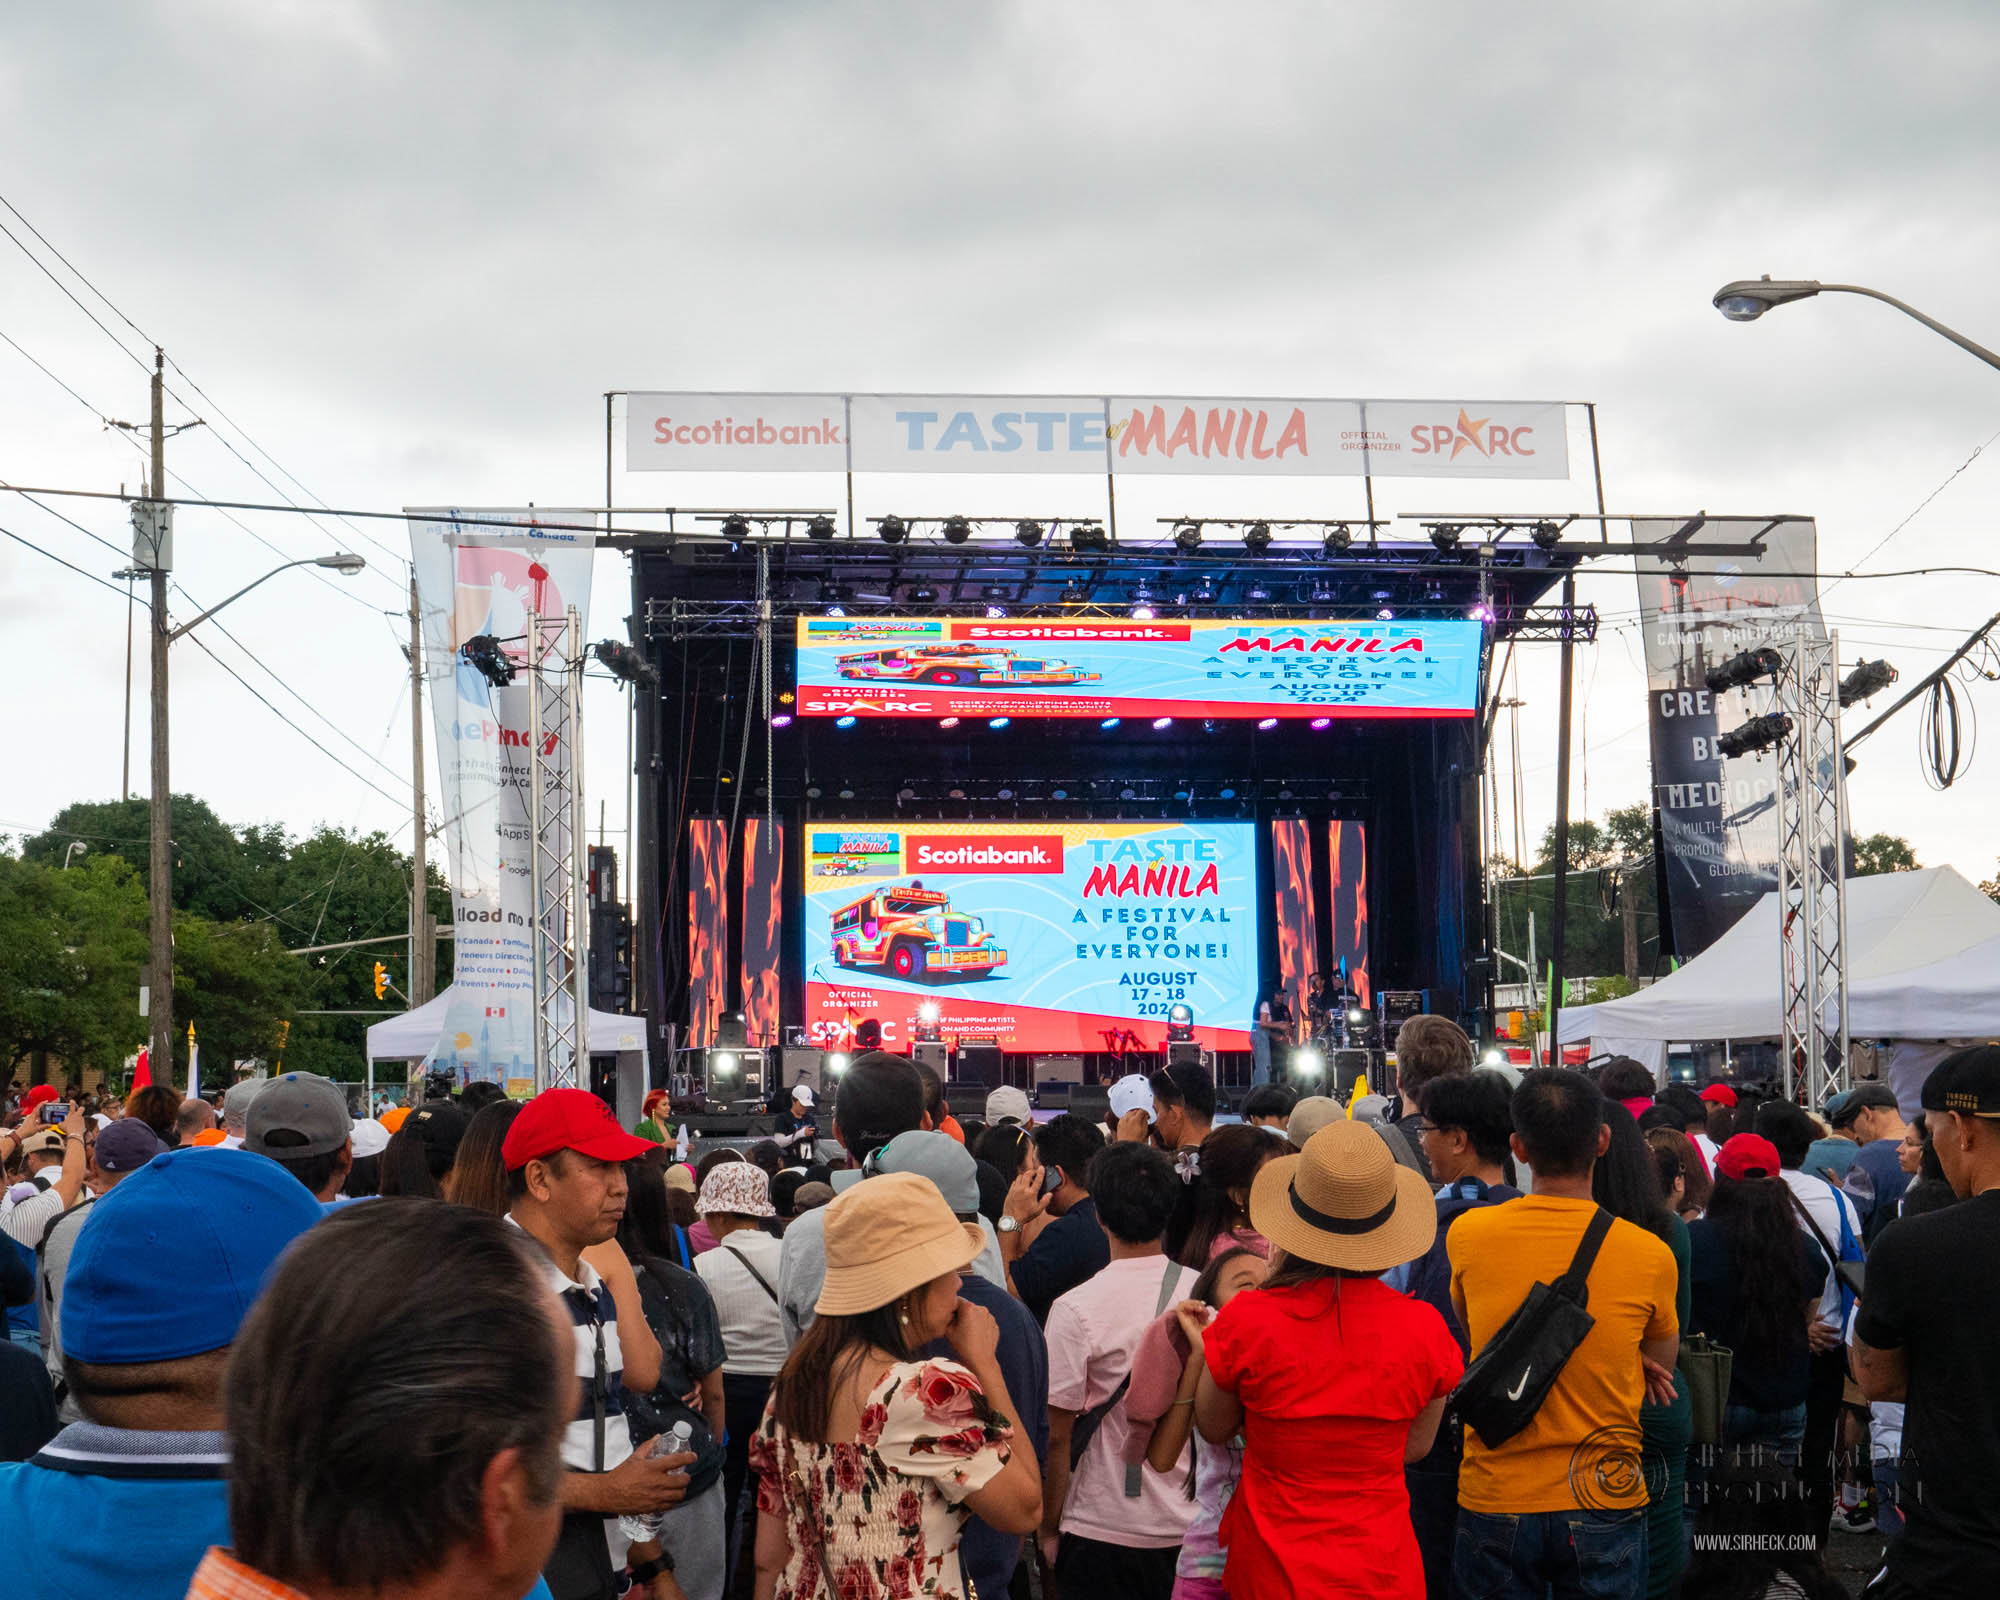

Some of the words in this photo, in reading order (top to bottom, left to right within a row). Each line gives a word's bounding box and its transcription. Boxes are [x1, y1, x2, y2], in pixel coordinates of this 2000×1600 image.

[895, 411, 1107, 452] TASTE
[1118, 404, 1309, 460] MANILA
[1340, 431, 1389, 441] OFFICIAL
[1341, 441, 1402, 452] ORGANIZER
[1225, 627, 1424, 638] TASTE
[1656, 630, 1713, 646] CANADA
[1217, 637, 1424, 653] MANILA
[1202, 656, 1225, 664] A
[1247, 656, 1440, 664] FESTIVAL
[1206, 671, 1434, 679] EVERYONE!
[839, 842, 889, 853] MANILA
[1086, 839, 1217, 862] TASTE
[1082, 863, 1219, 898] MANILA
[1072, 908, 1088, 923] A
[1102, 908, 1231, 923] FESTIVAL
[1126, 926, 1178, 941] FOR
[460, 952, 493, 961] reneurs
[1076, 943, 1228, 959] EVERYONE!
[1119, 972, 1198, 986] AUGUST
[1131, 988, 1149, 1000] 17
[1167, 988, 1185, 1000] 18
[1137, 1002, 1172, 1015] 202
